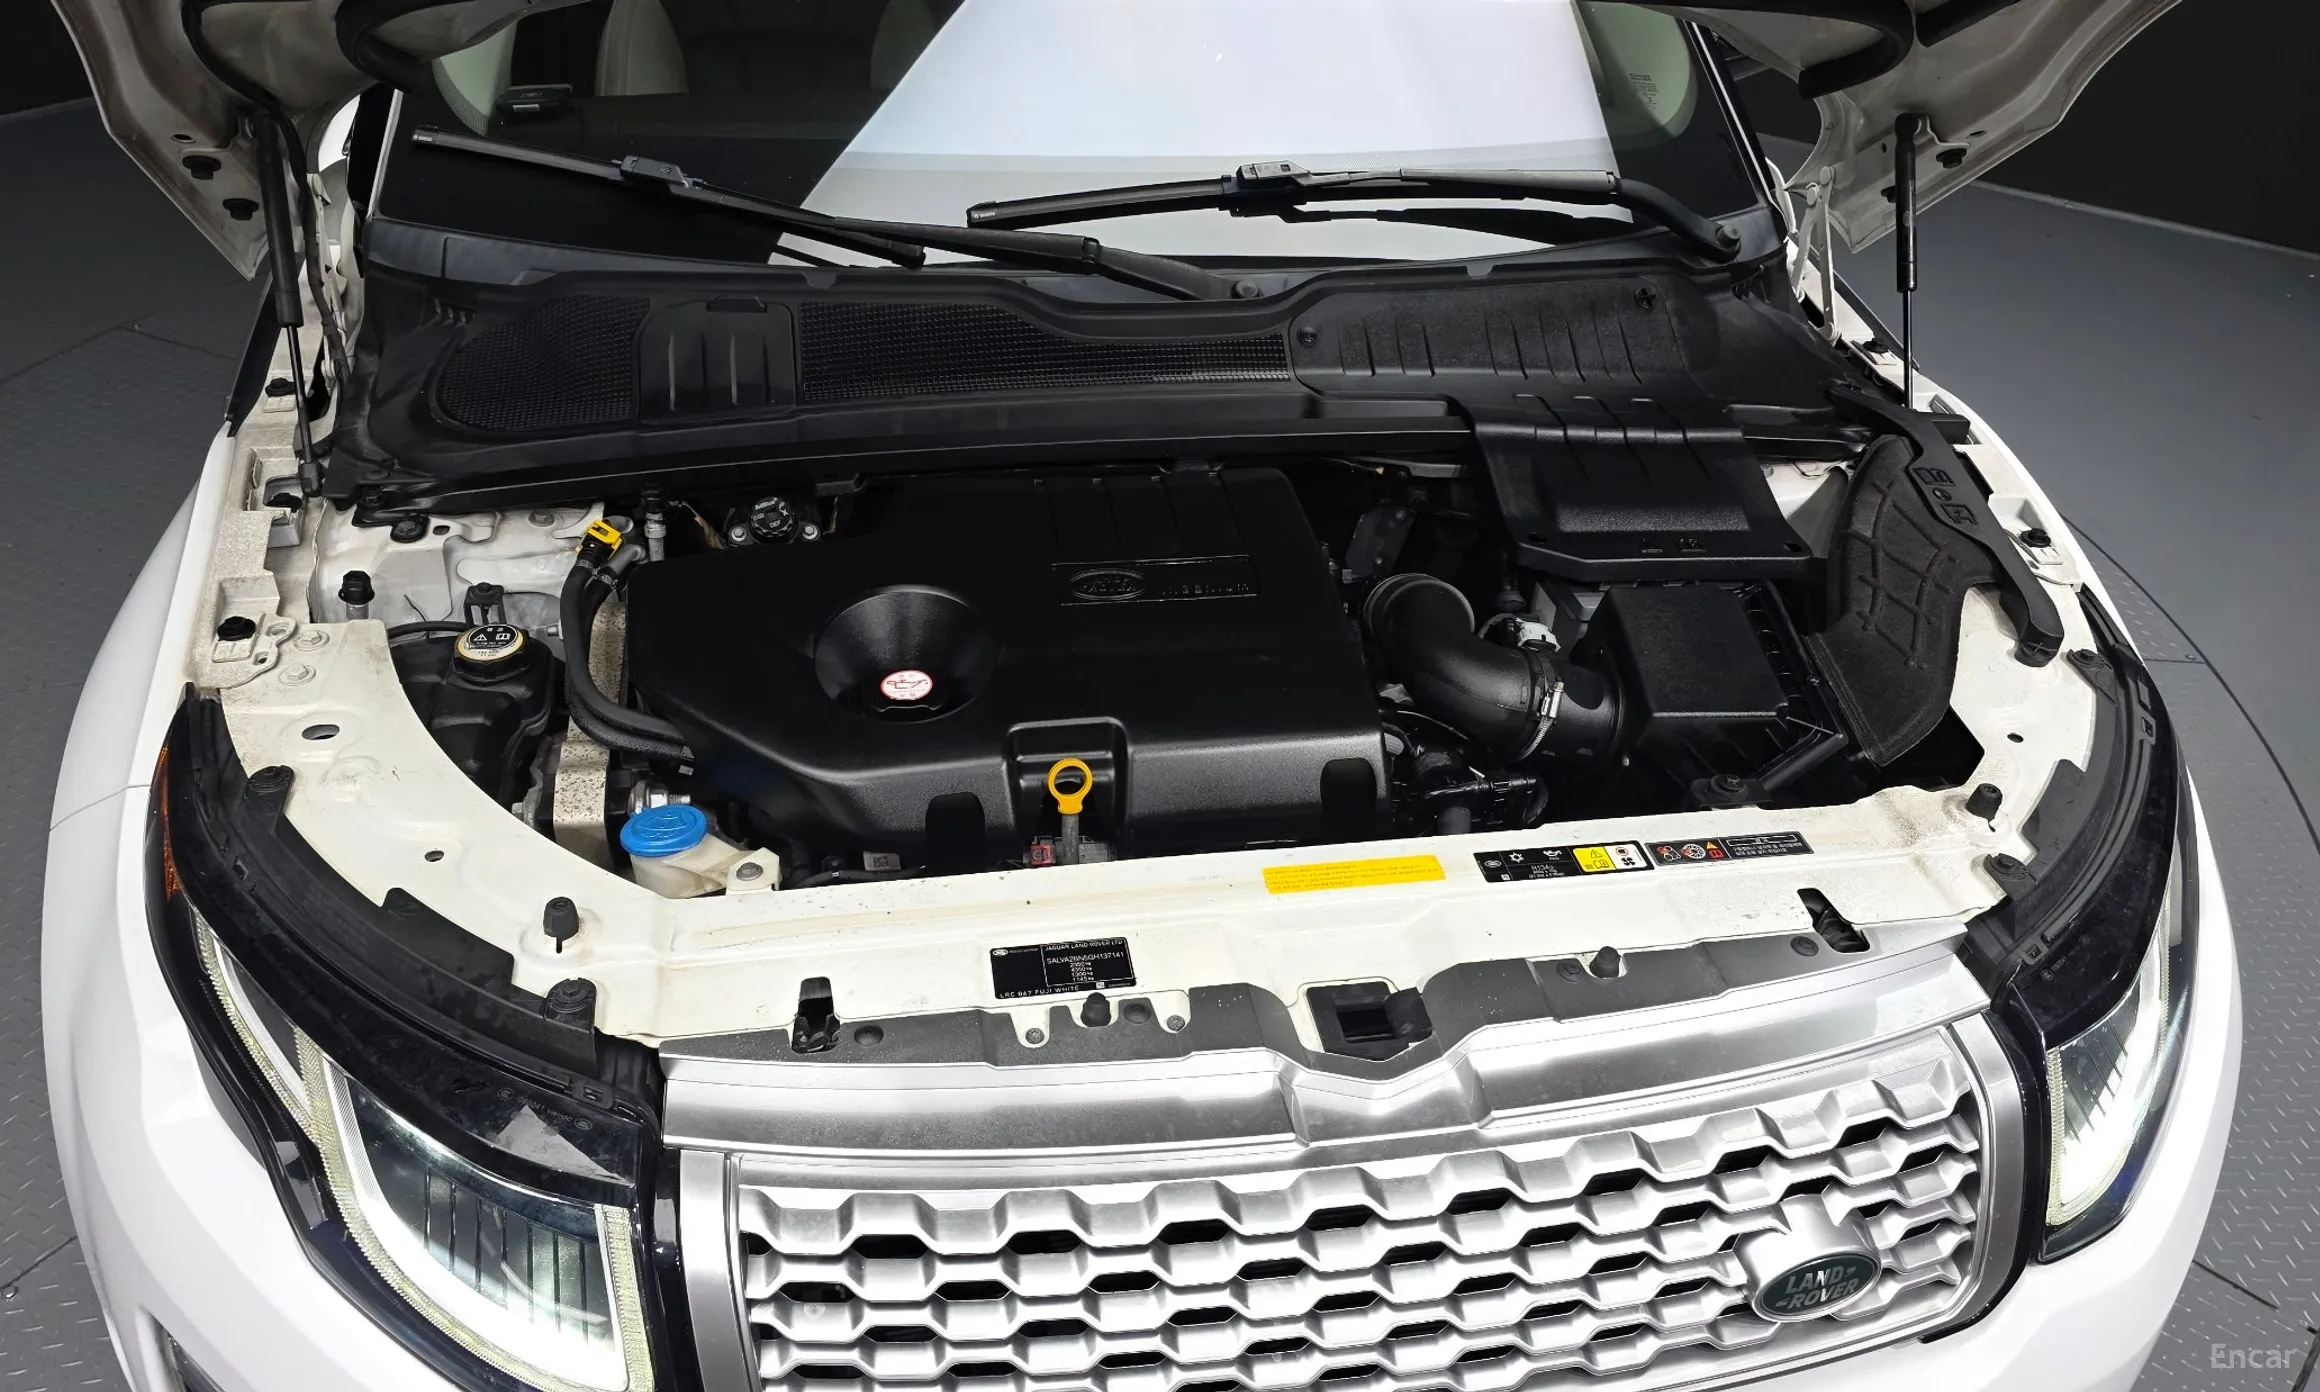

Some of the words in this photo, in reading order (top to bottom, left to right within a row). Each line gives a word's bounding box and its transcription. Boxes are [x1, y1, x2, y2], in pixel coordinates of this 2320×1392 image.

[999, 991, 1015, 999] LRC
[1054, 985, 1079, 993] WHITE
[1784, 1265, 1845, 1294] LAND
[1787, 1278, 1859, 1310] ROVER
